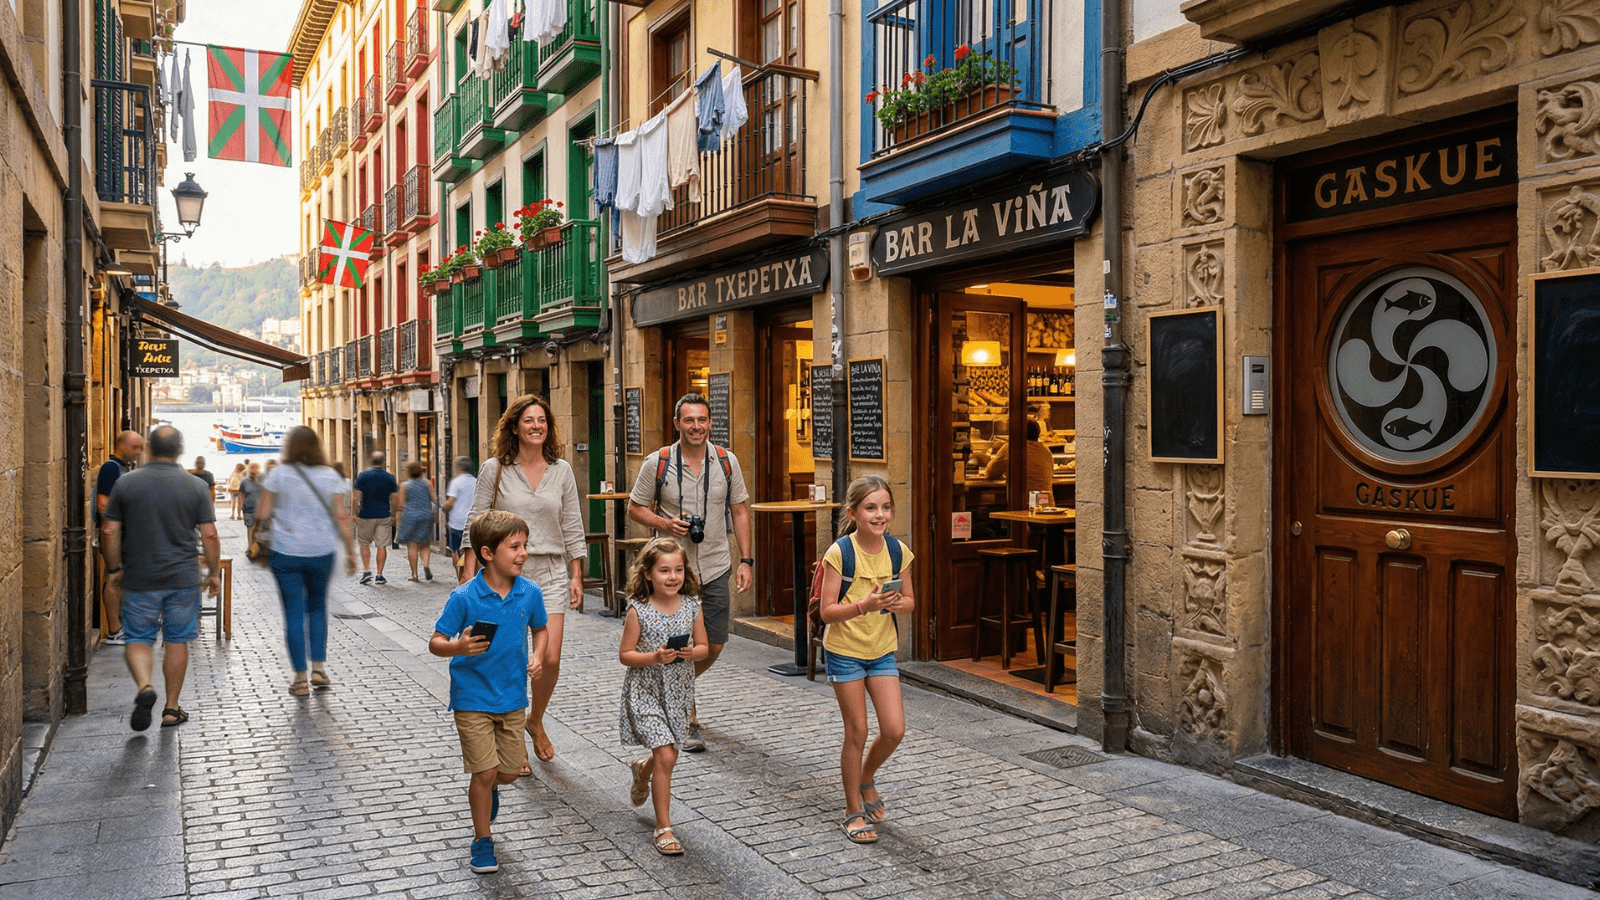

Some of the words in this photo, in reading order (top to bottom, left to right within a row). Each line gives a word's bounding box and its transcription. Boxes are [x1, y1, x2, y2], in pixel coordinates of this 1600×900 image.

[1314, 137, 1502, 209] GASKUE
[885, 221, 933, 263] BAR
[945, 208, 980, 249] LA
[678, 282, 707, 311] BAR
[714, 255, 812, 304] TXEPETXA
[1355, 482, 1455, 512] GASKUE
